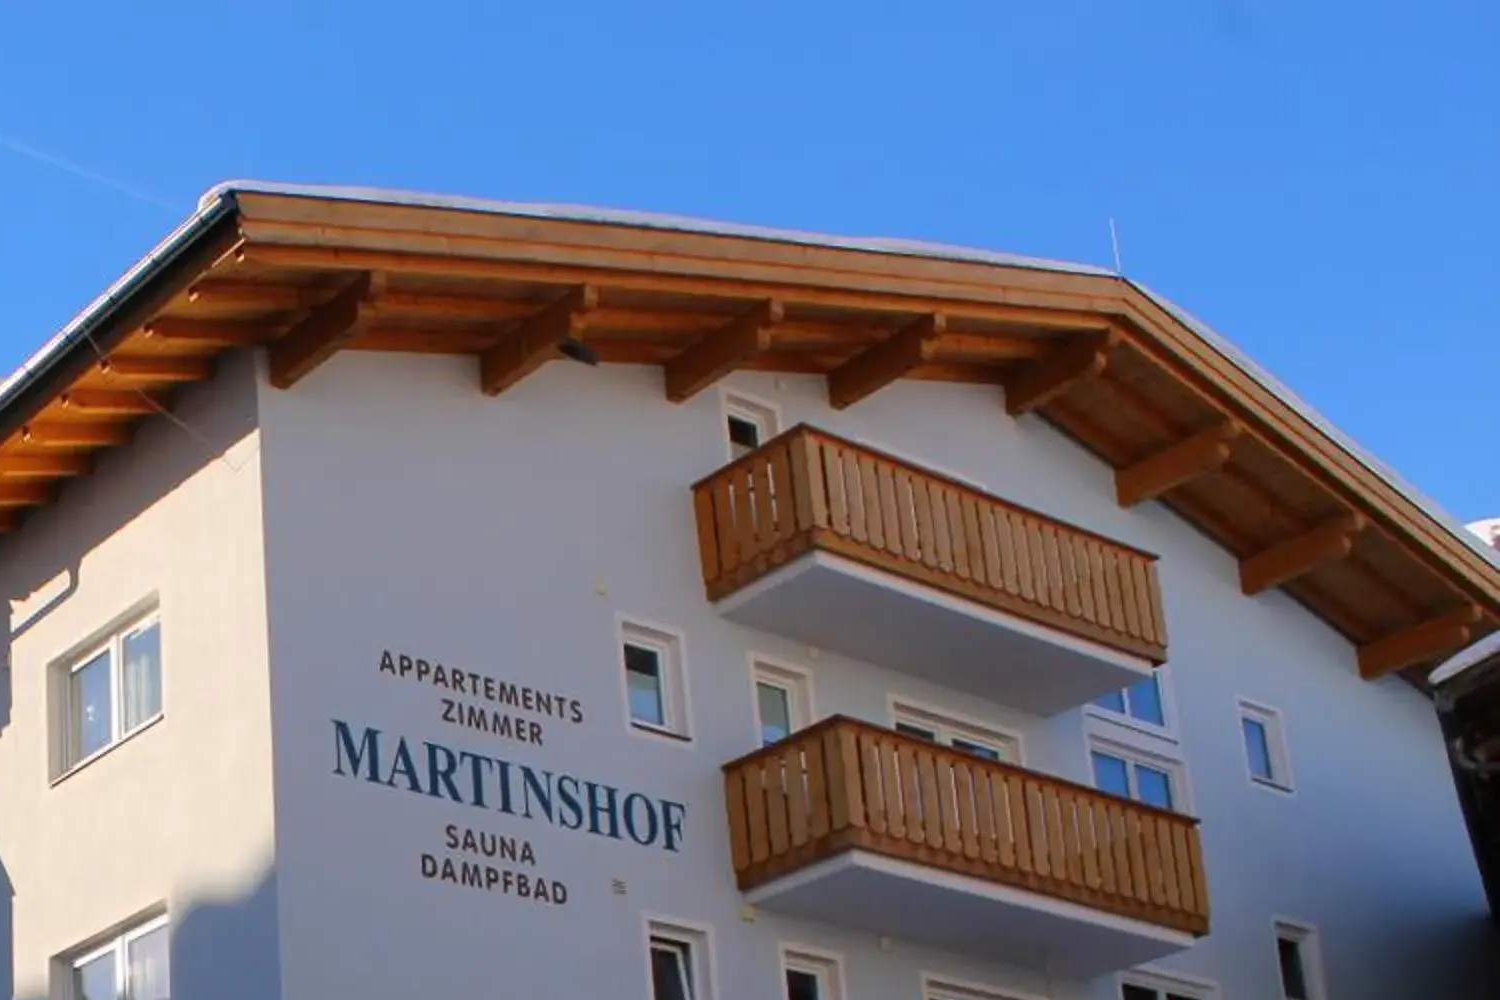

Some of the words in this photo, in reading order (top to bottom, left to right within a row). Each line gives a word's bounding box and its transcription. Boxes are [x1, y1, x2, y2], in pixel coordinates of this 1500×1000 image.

[380, 650, 584, 723] APPARTEMENTS
[441, 698, 543, 746] ZIMMER
[330, 719, 686, 853] MARTINSHOF
[445, 824, 536, 866] SAUNA
[421, 854, 568, 905] DAMPFBAD
